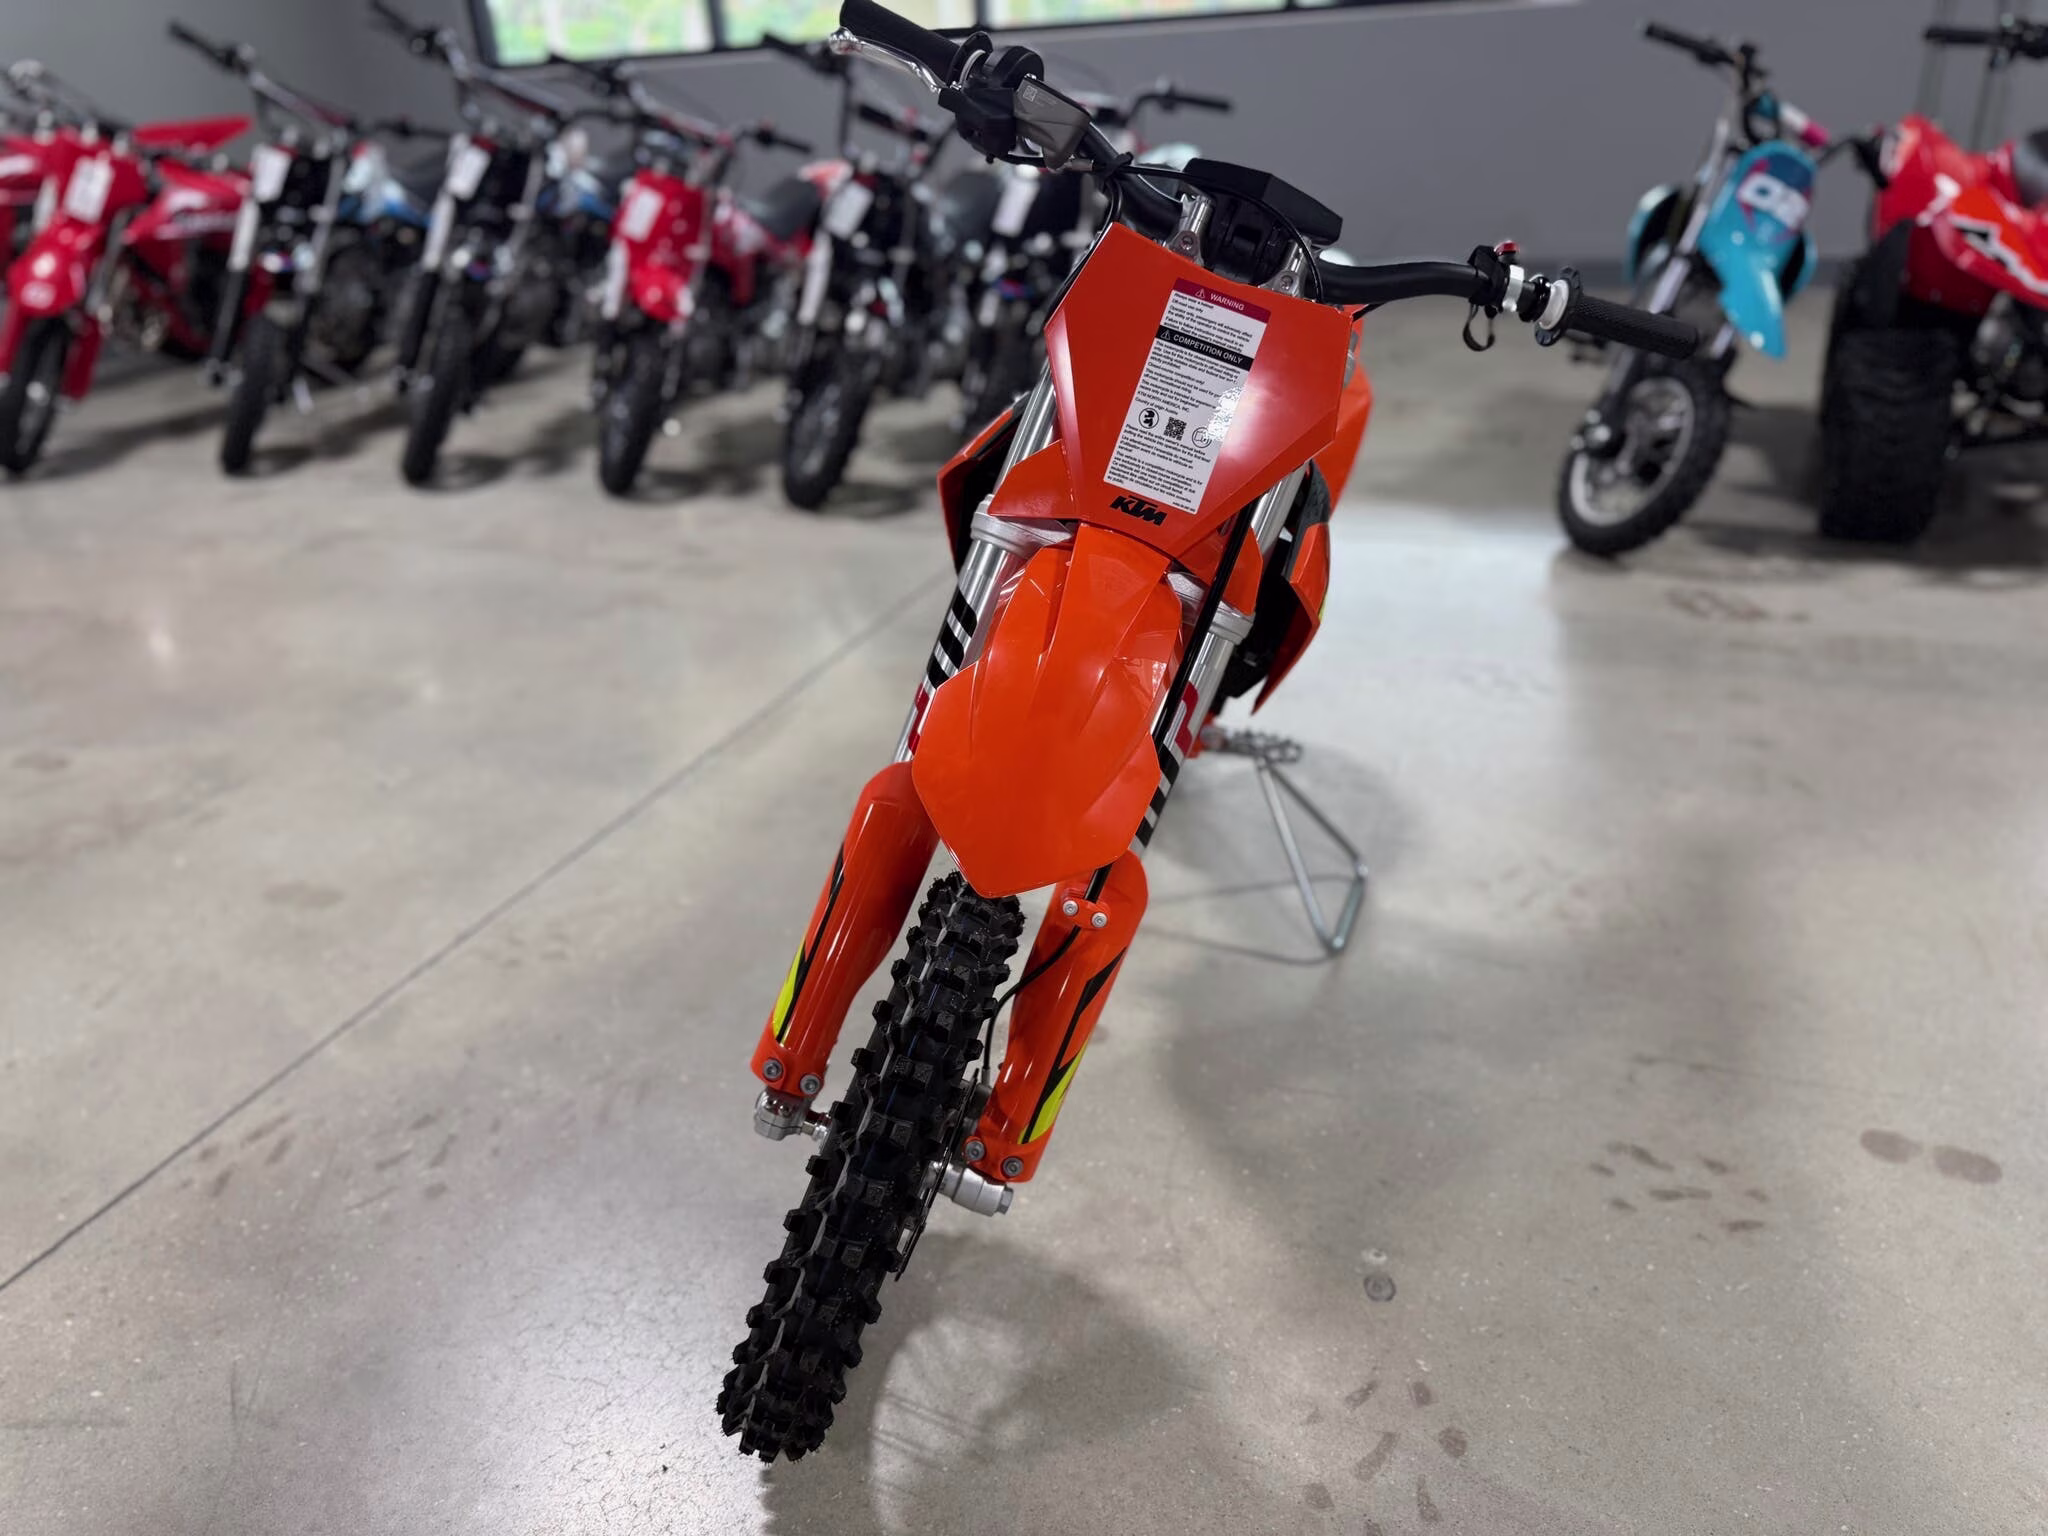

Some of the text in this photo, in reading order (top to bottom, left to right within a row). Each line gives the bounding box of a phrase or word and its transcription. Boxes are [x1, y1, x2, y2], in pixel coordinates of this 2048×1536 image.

[1209, 292, 1245, 311] WARNING
[1172, 333, 1222, 357] COMPETITION
[1222, 351, 1243, 364] ONLY
[1110, 495, 1168, 526] KTM
